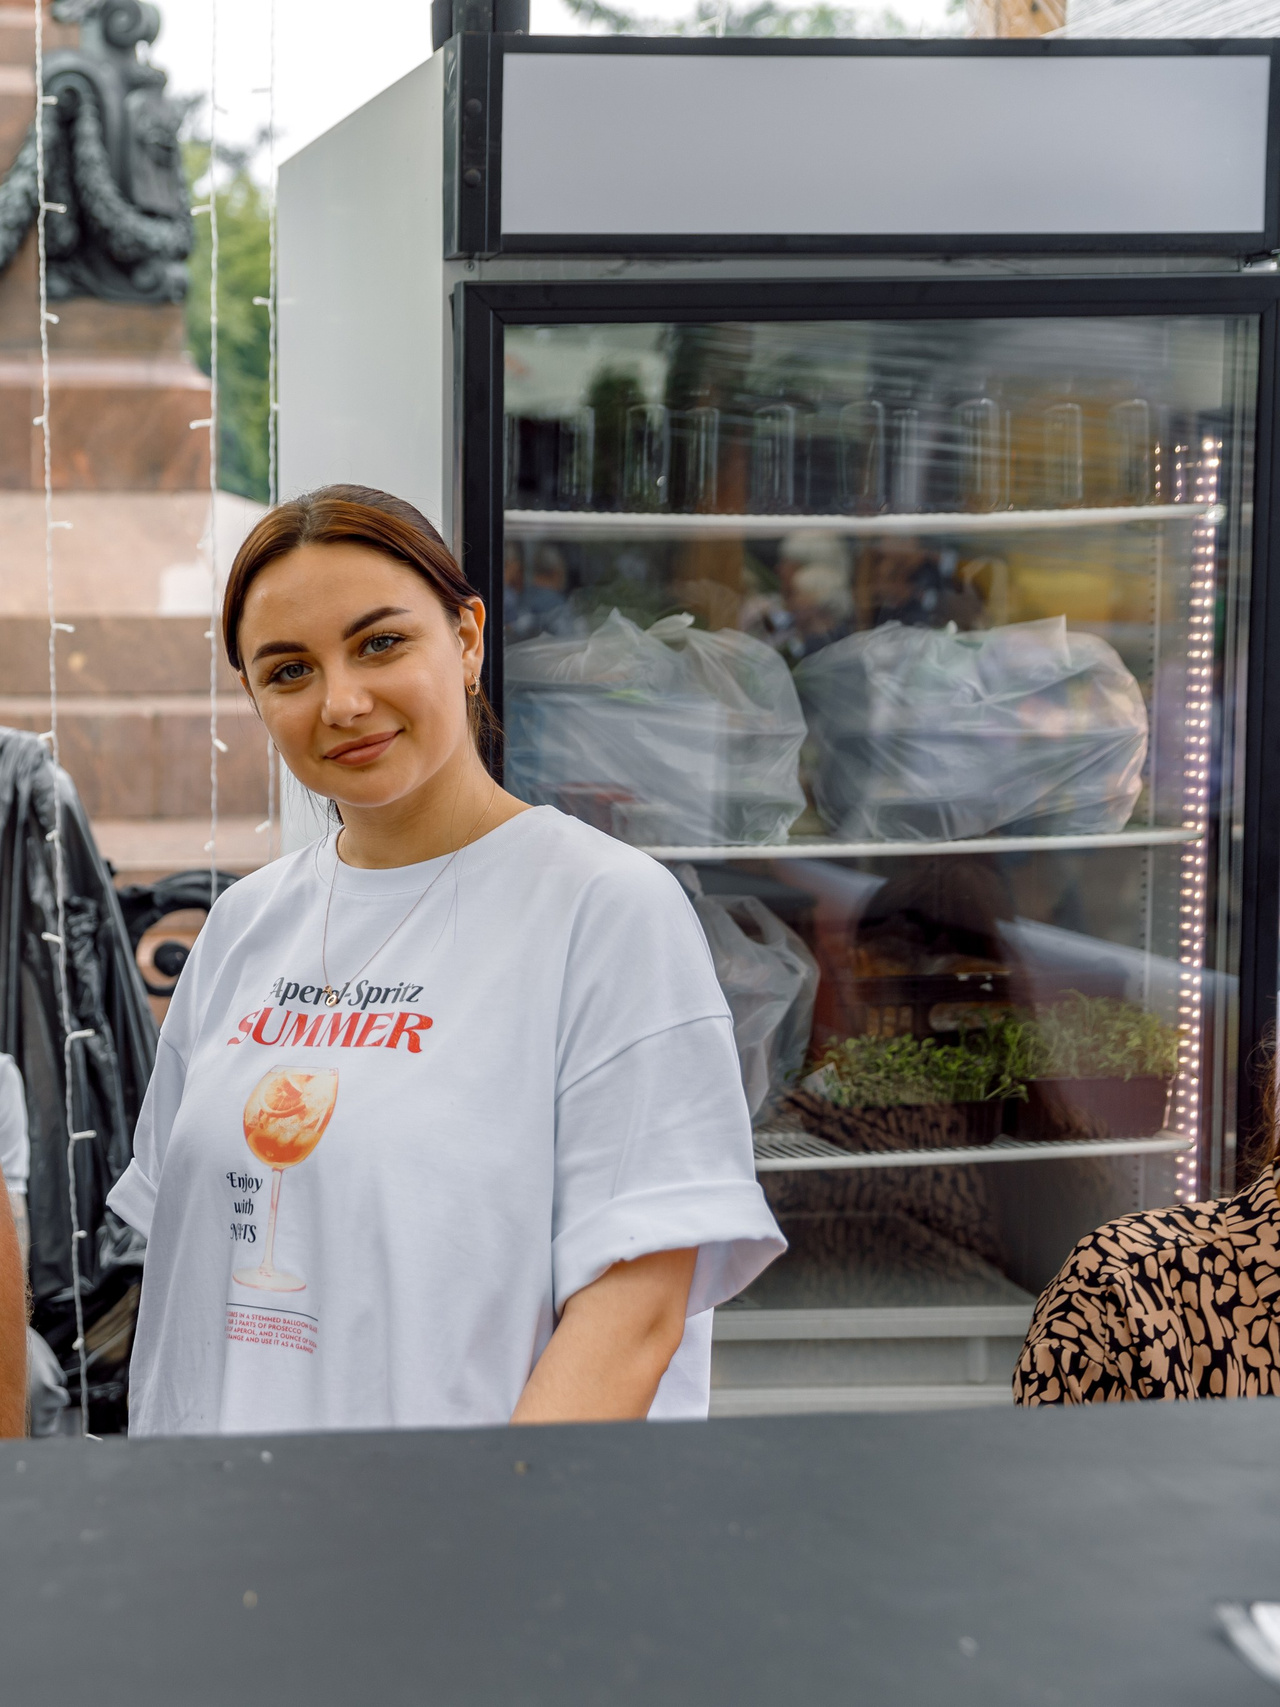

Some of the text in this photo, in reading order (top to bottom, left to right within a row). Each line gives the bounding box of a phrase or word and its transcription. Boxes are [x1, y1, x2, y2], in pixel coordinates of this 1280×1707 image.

[227, 1007, 434, 1054] SUMMER
[226, 1171, 263, 1194] Enjoy
[233, 1198, 254, 1216] with
[239, 1319, 256, 1328] PARTS
[268, 1323, 302, 1335] PROSECCO
[251, 1314, 281, 1323] STEMMED
[283, 1317, 309, 1328] BALLOON
[234, 1327, 257, 1336] APEROL,
[280, 1332, 302, 1342] OUNCE
[245, 1335, 260, 1343] AND
[261, 1337, 272, 1345] USE
[273, 1338, 280, 1346] IT
[281, 1340, 289, 1348] AS
